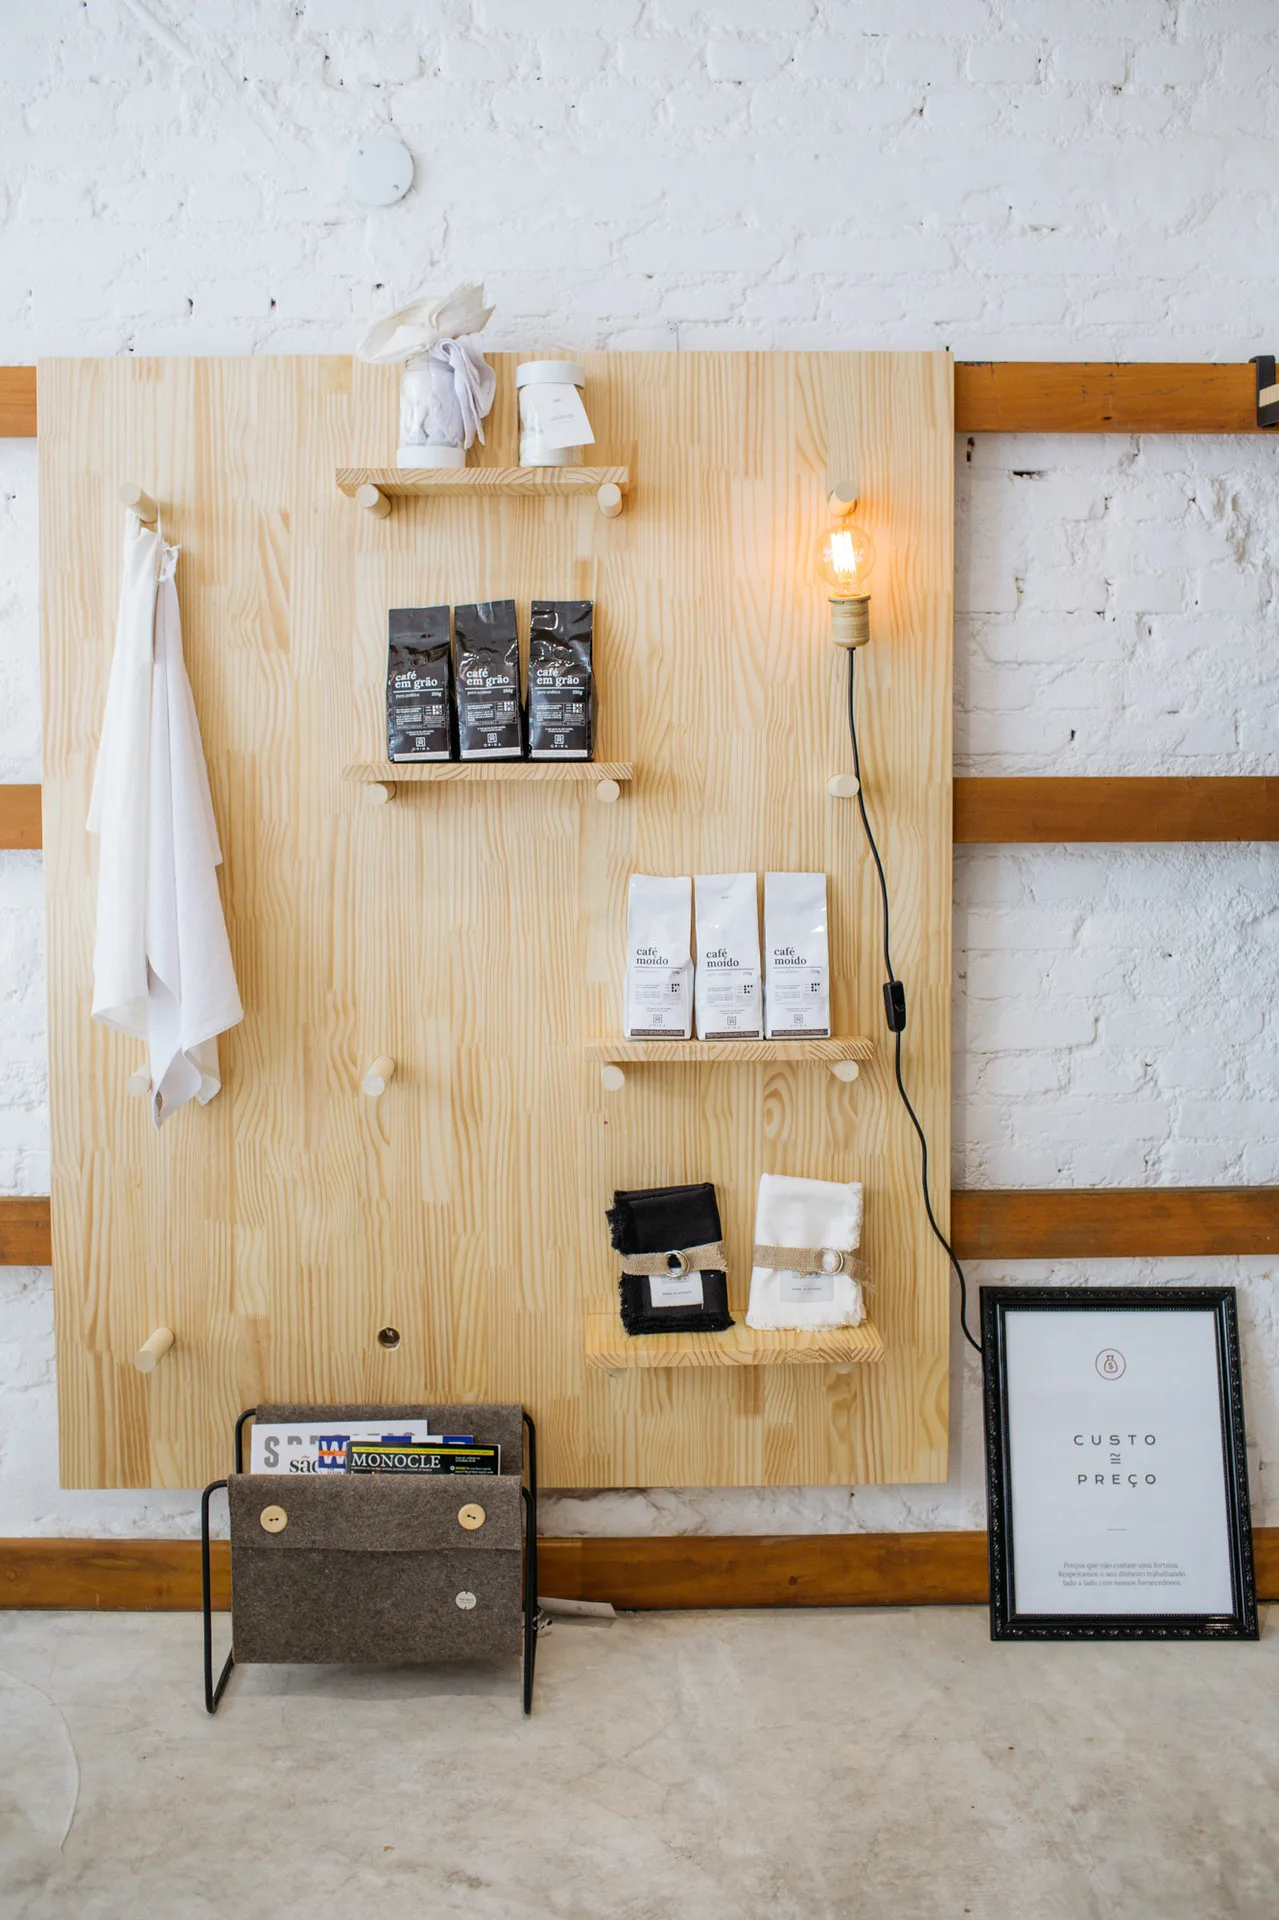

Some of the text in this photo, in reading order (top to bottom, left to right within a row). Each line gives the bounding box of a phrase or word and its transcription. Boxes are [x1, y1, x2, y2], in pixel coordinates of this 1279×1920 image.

[395, 671, 417, 682] café
[466, 668, 488, 678] café
[537, 668, 558, 676] café
[414, 677, 438, 690] grão
[486, 674, 509, 687] grão
[555, 675, 579, 687] grão
[636, 947, 657, 956] café
[706, 948, 727, 958] café
[774, 947, 795, 956] café
[636, 956, 668, 965] moído
[707, 957, 739, 967] moído
[774, 956, 807, 965] moído
[1074, 1435, 1156, 1446] CUSTO
[351, 1453, 440, 1468] MONOCLE
[1078, 1474, 1156, 1488] PREÇO
[1063, 1562, 1085, 1571] Preços
